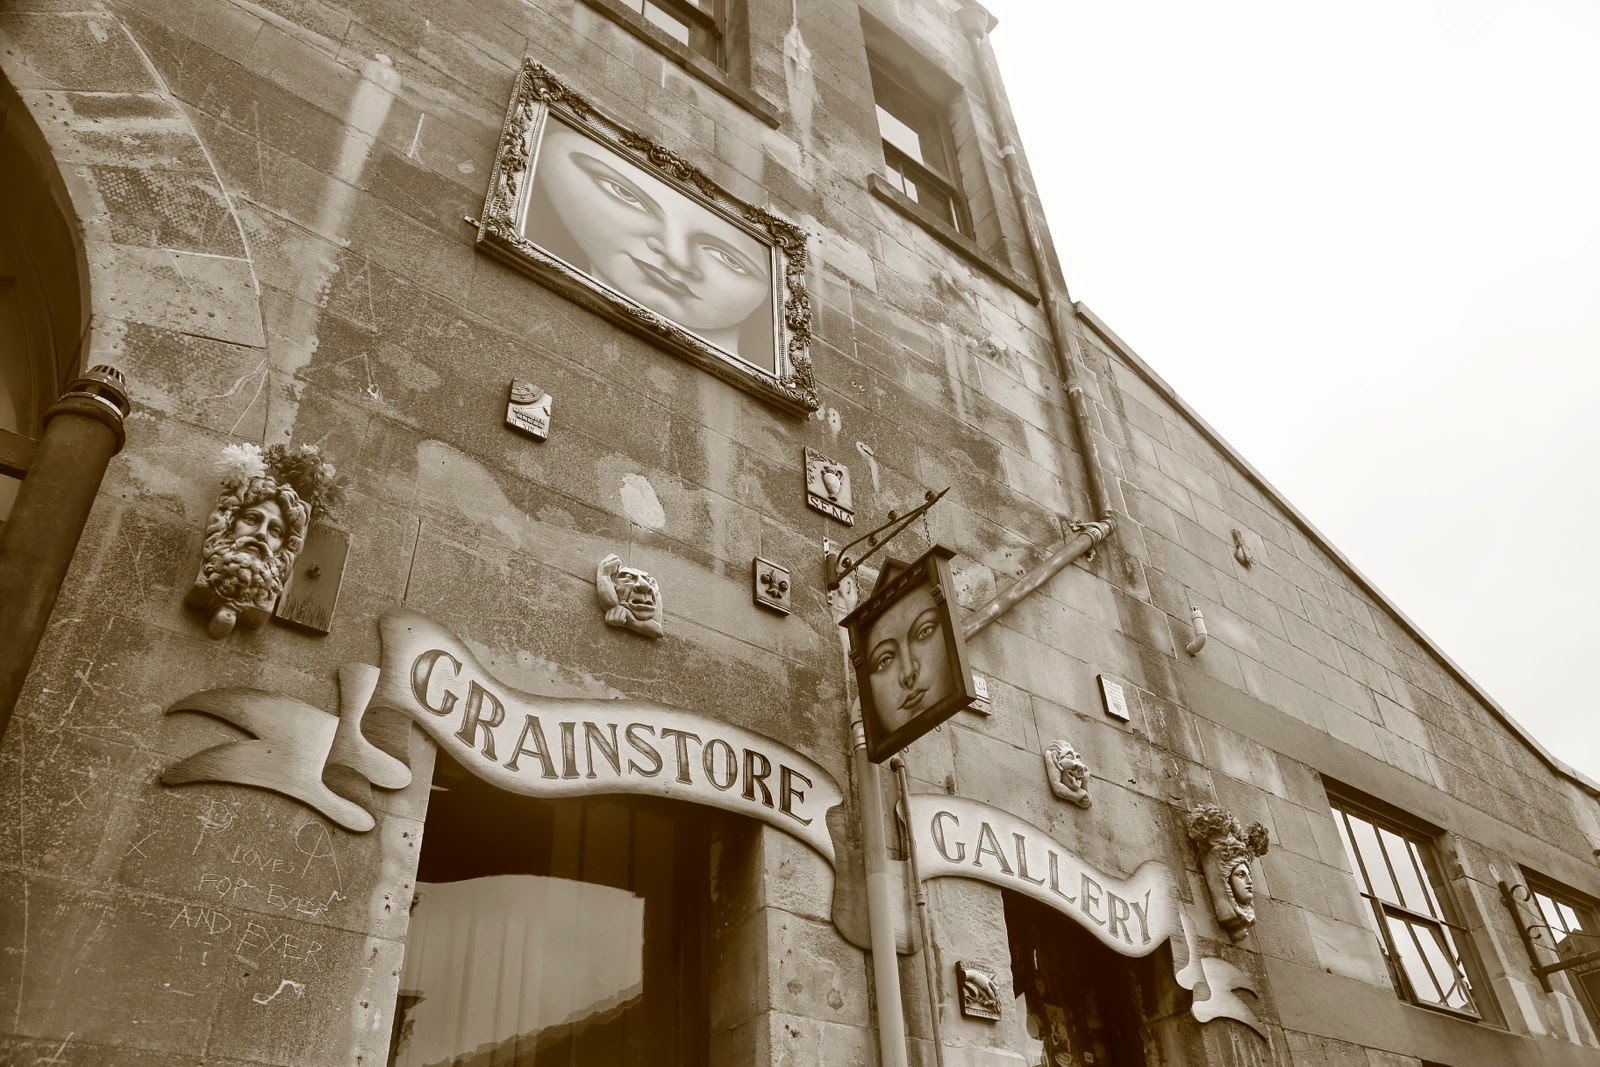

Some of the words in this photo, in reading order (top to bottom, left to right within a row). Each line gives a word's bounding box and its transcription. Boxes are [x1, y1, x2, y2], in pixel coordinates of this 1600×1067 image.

[410, 648, 814, 826] GRAINSTORE
[198, 873, 249, 901] FOR
[930, 810, 1153, 946] GALLERY
[169, 905, 232, 935] AND
